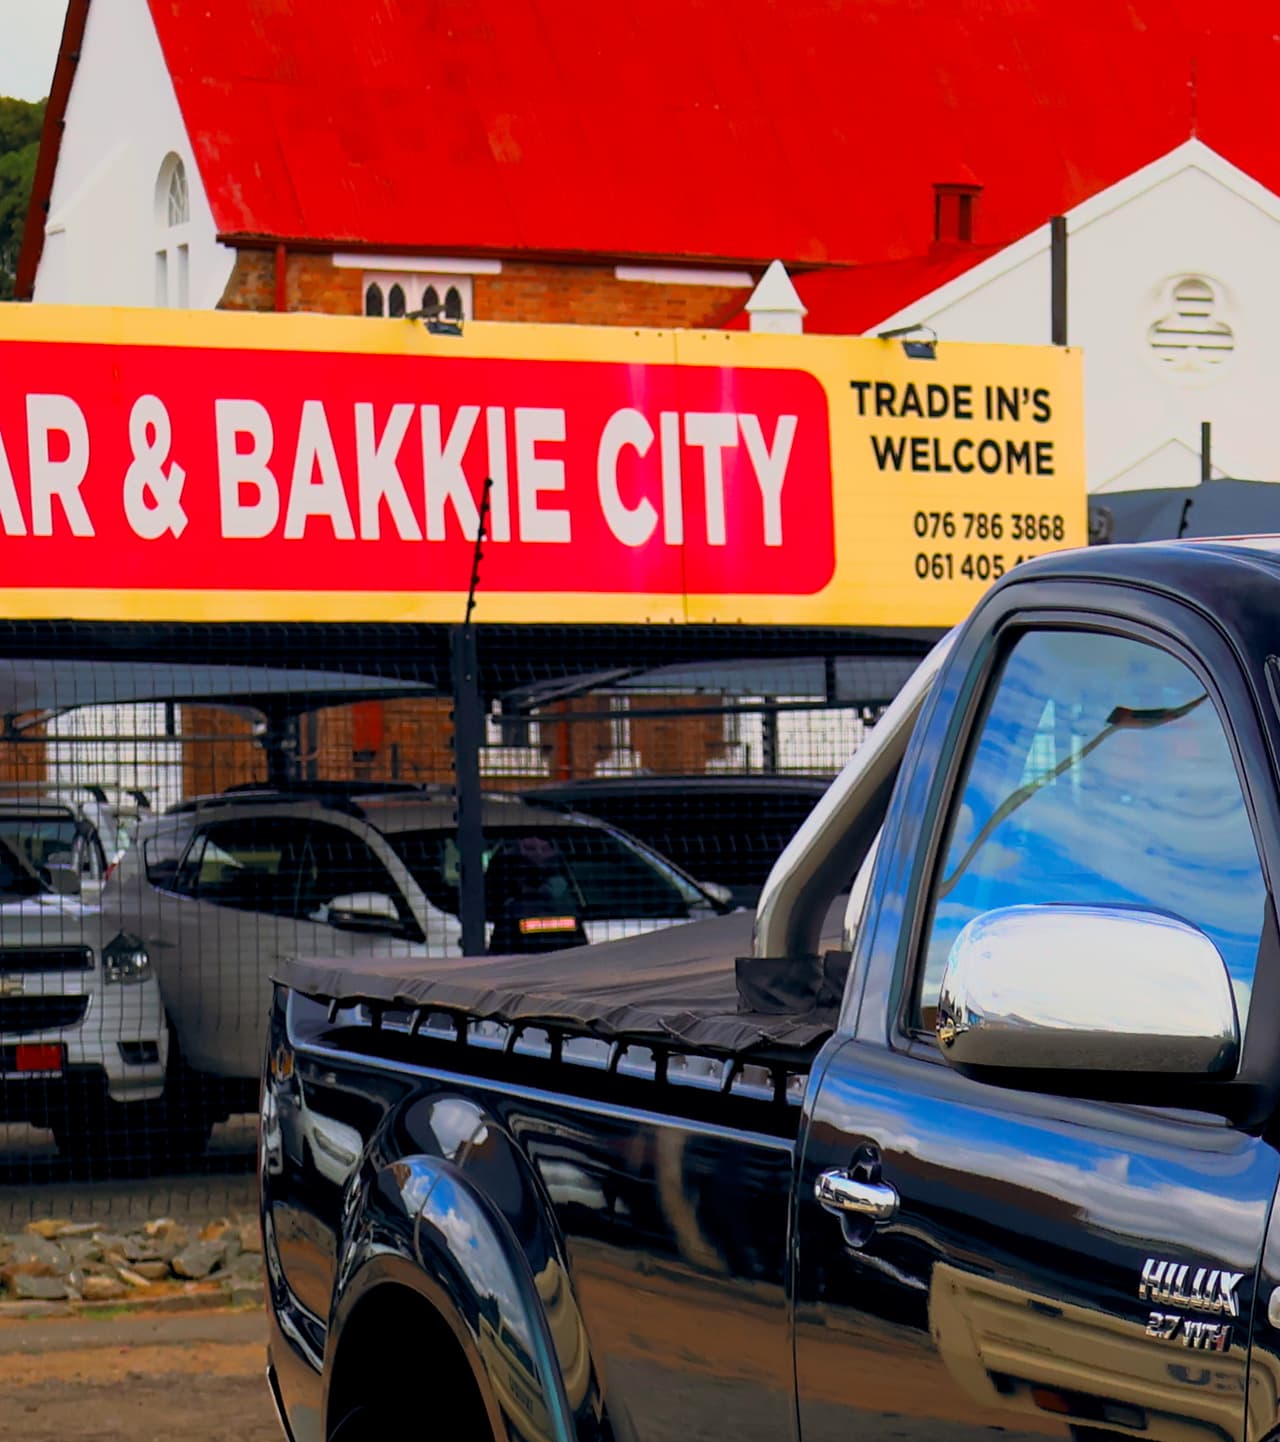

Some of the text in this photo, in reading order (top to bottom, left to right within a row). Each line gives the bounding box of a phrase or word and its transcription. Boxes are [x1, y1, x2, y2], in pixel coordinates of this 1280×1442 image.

[850, 380, 1052, 423] TRADE IN'S
[123, 394, 188, 540] &
[215, 399, 572, 544] BAKKIE
[597, 407, 798, 547] CITY
[870, 435, 1055, 476] WELCOME
[914, 511, 1065, 541] 076 786 3868
[915, 553, 953, 580] 061
[960, 553, 1005, 581] 405
[1139, 1258, 1245, 1317] HILUX
